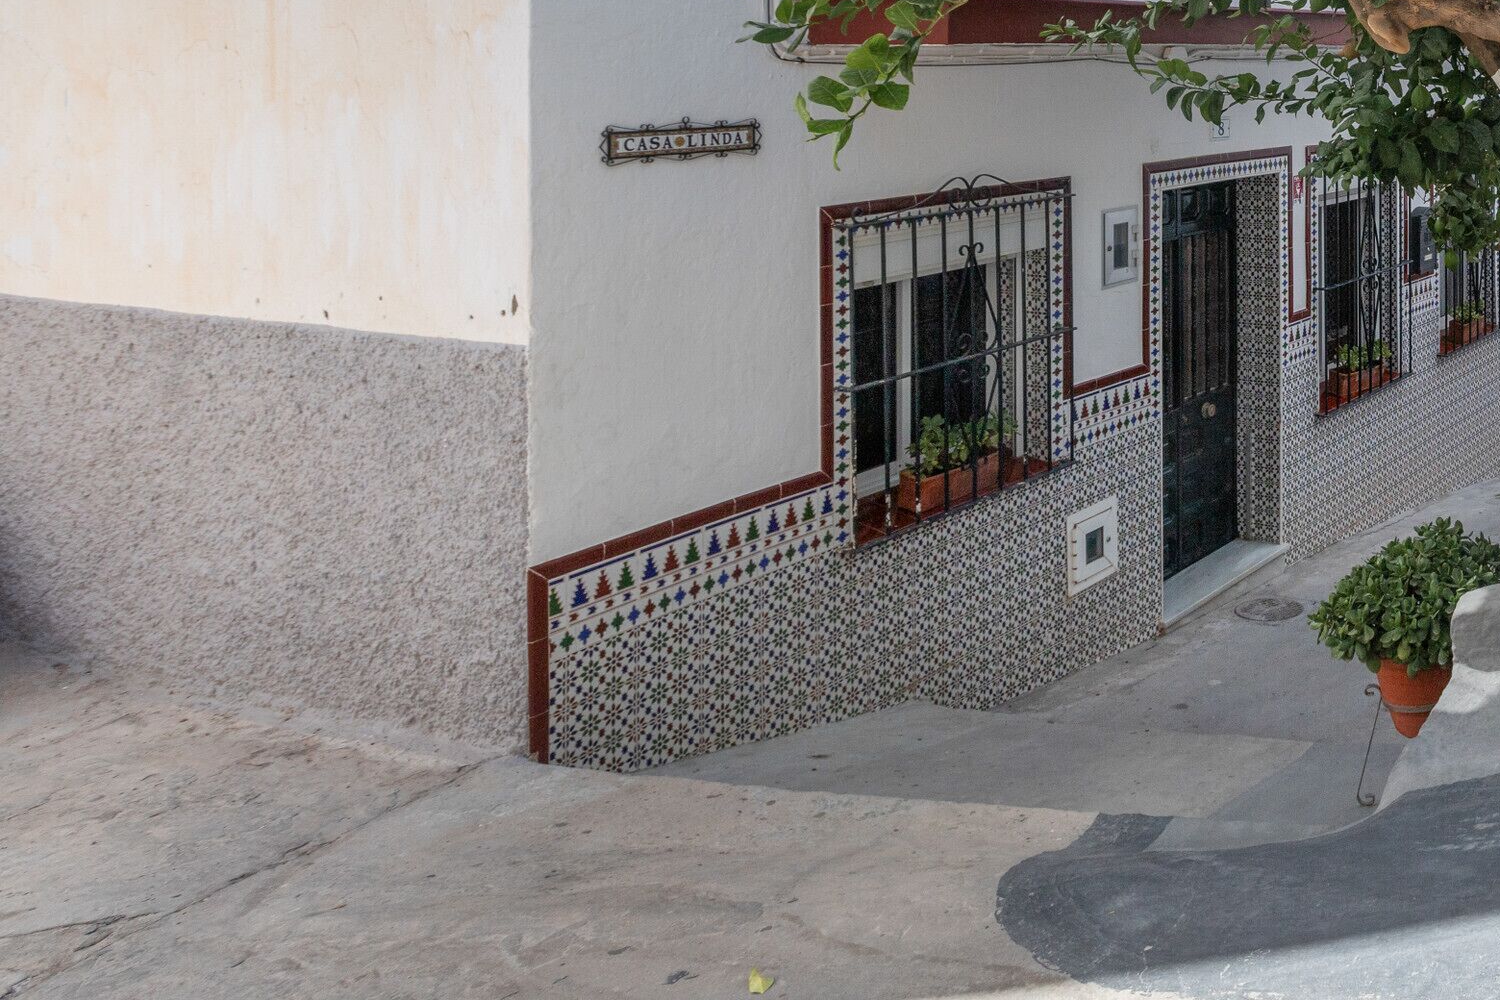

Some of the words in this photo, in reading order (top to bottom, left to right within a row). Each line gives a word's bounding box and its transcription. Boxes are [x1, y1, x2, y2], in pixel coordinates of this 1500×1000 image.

[1217, 121, 1225, 136] 8
[624, 137, 673, 151] CASA
[687, 131, 743, 147] LINDA
